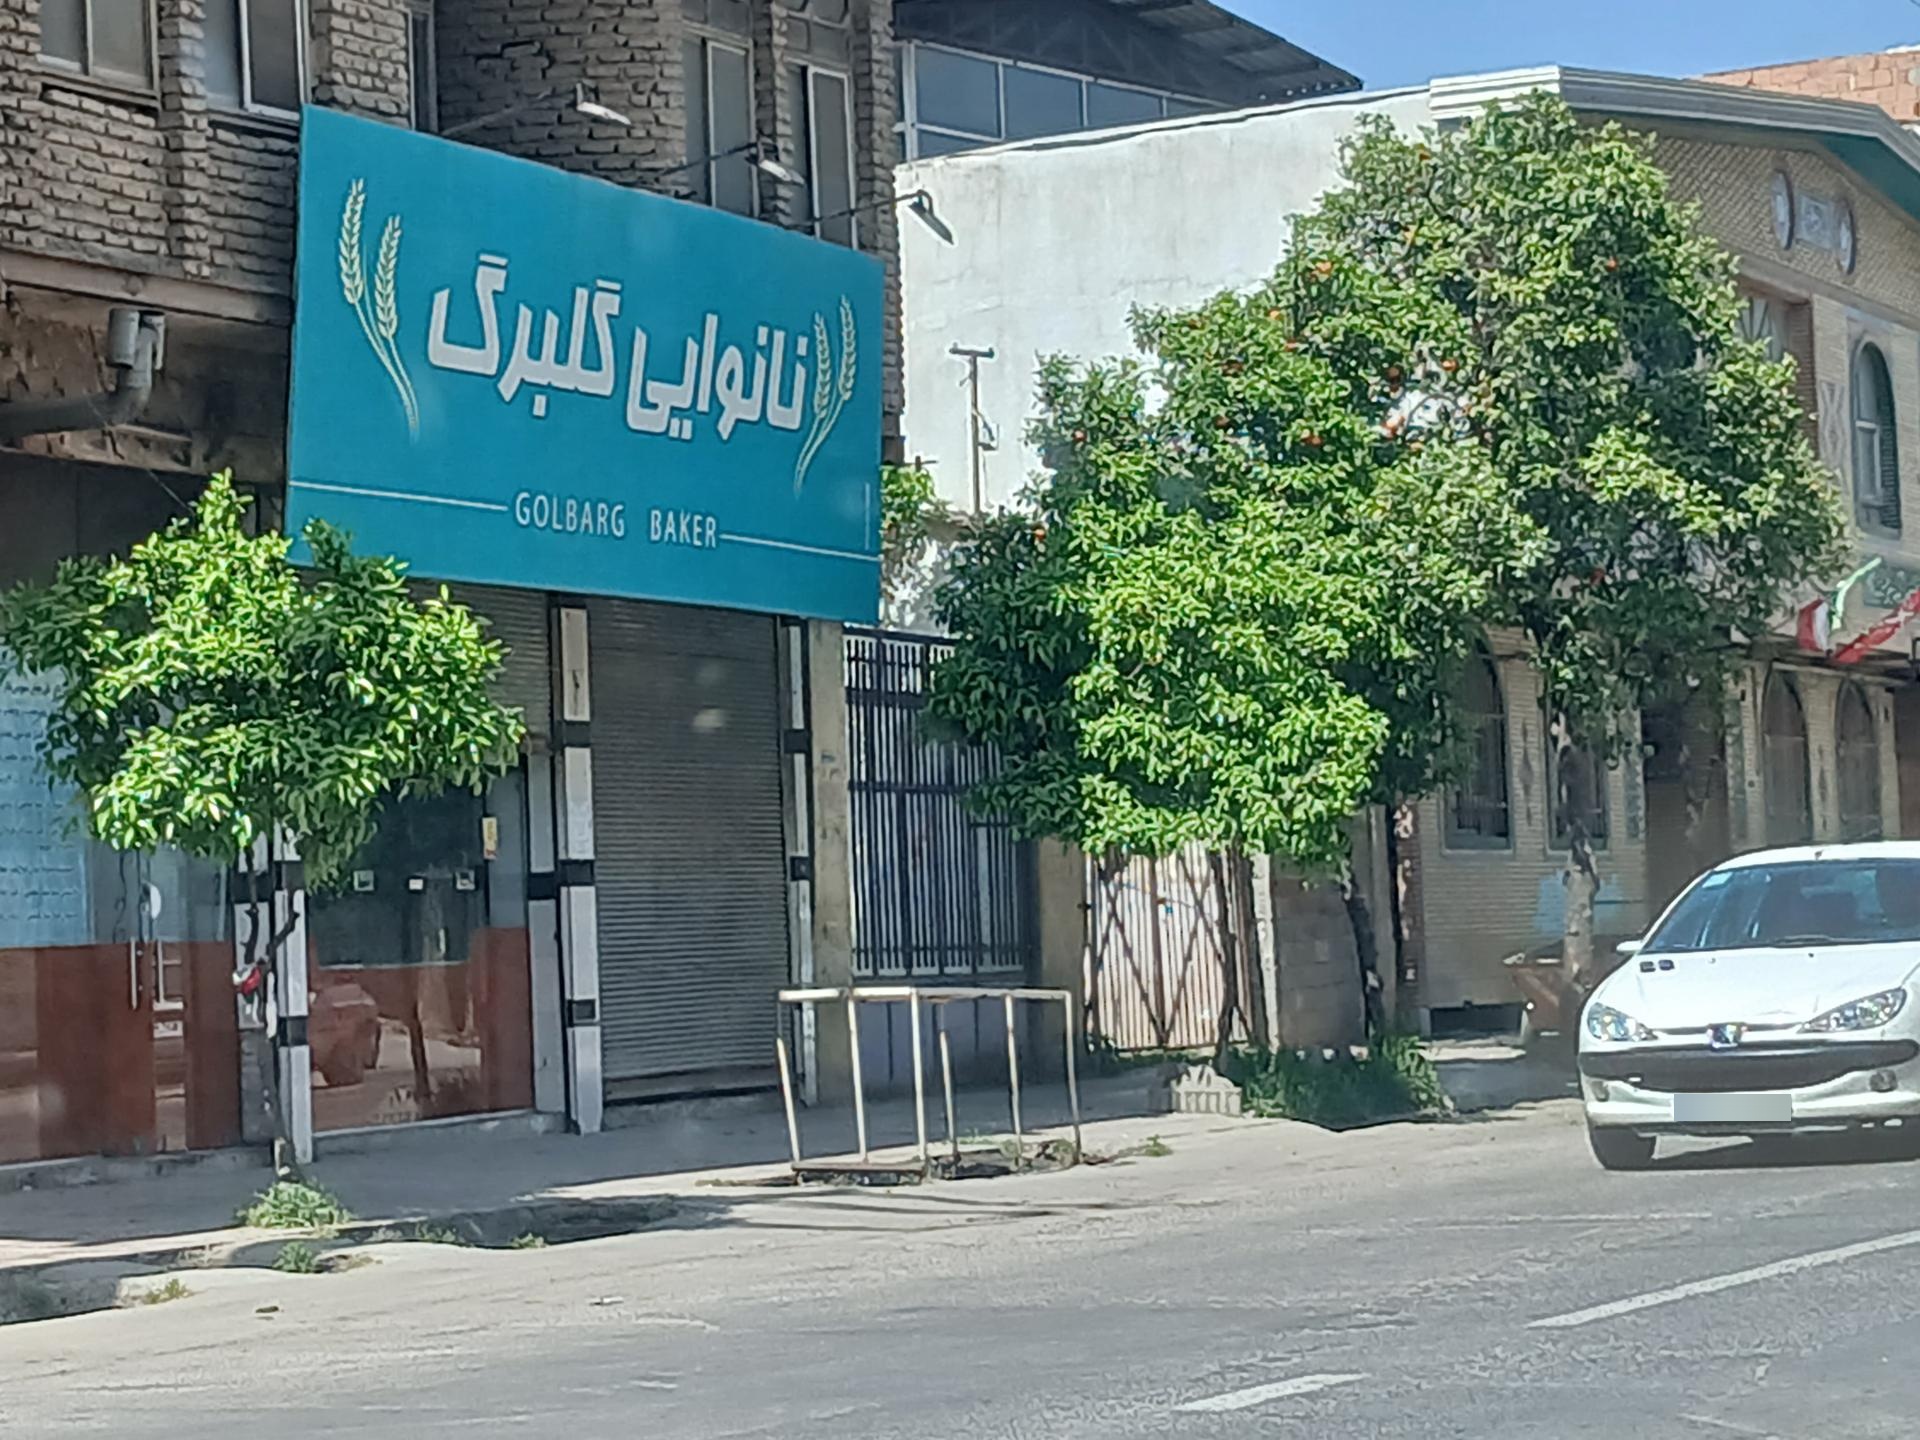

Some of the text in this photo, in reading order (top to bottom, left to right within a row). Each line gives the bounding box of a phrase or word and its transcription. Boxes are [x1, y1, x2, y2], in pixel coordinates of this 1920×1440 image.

[427, 253, 808, 441] نانوایی گلبرگ
[514, 491, 717, 548] GOLBARG BAKER
